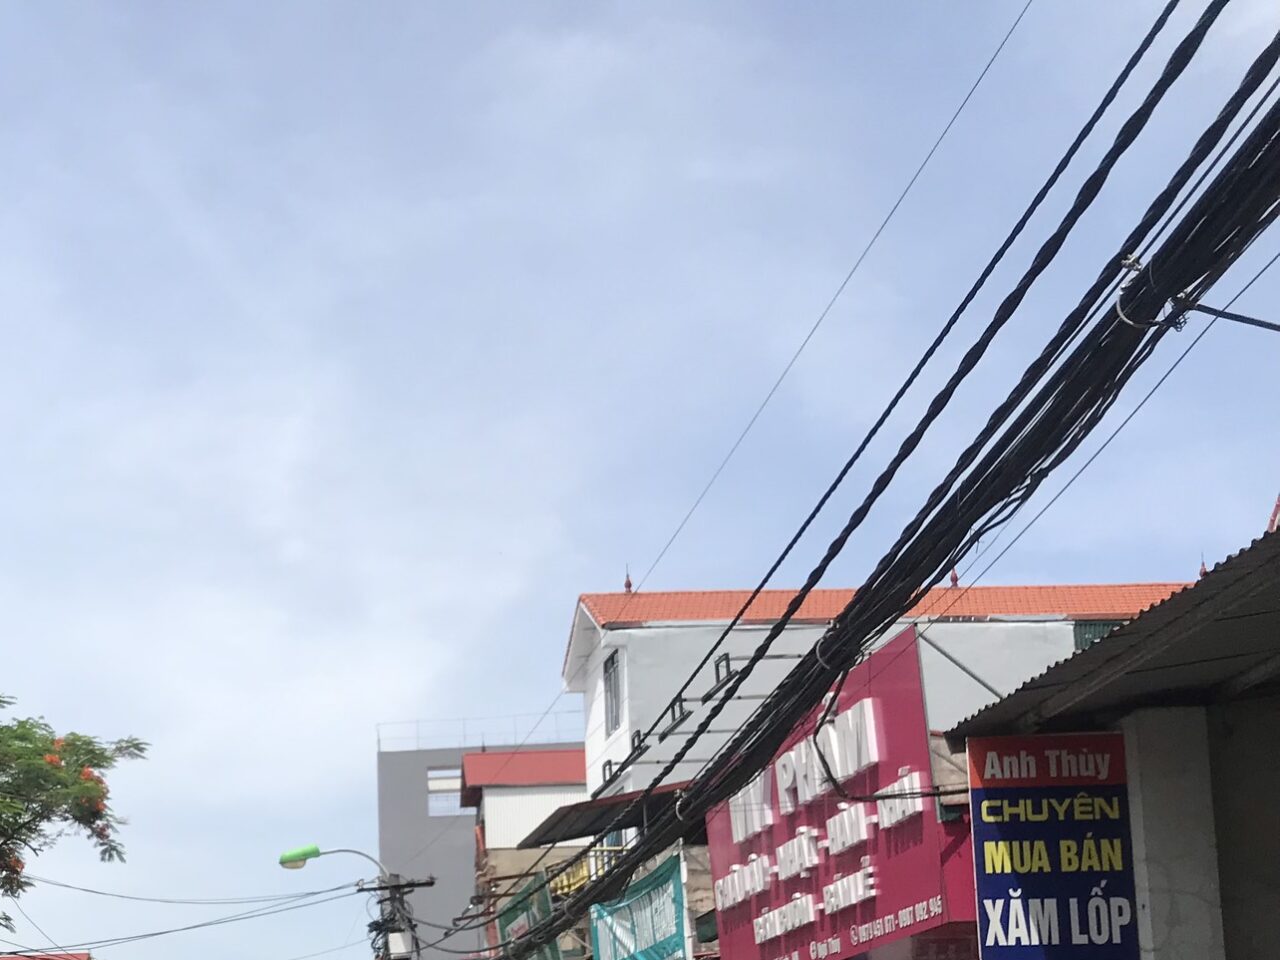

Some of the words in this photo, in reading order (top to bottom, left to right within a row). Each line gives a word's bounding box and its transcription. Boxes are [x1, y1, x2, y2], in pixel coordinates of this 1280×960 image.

[983, 751, 1037, 780] Anh
[1045, 748, 1111, 780] Thùy
[980, 792, 1120, 823] CHUYÊN
[983, 839, 1051, 874] MUA
[1059, 832, 1123, 873] BÁN
[983, 888, 1060, 946] XĂM
[1069, 879, 1131, 946] LỐP
